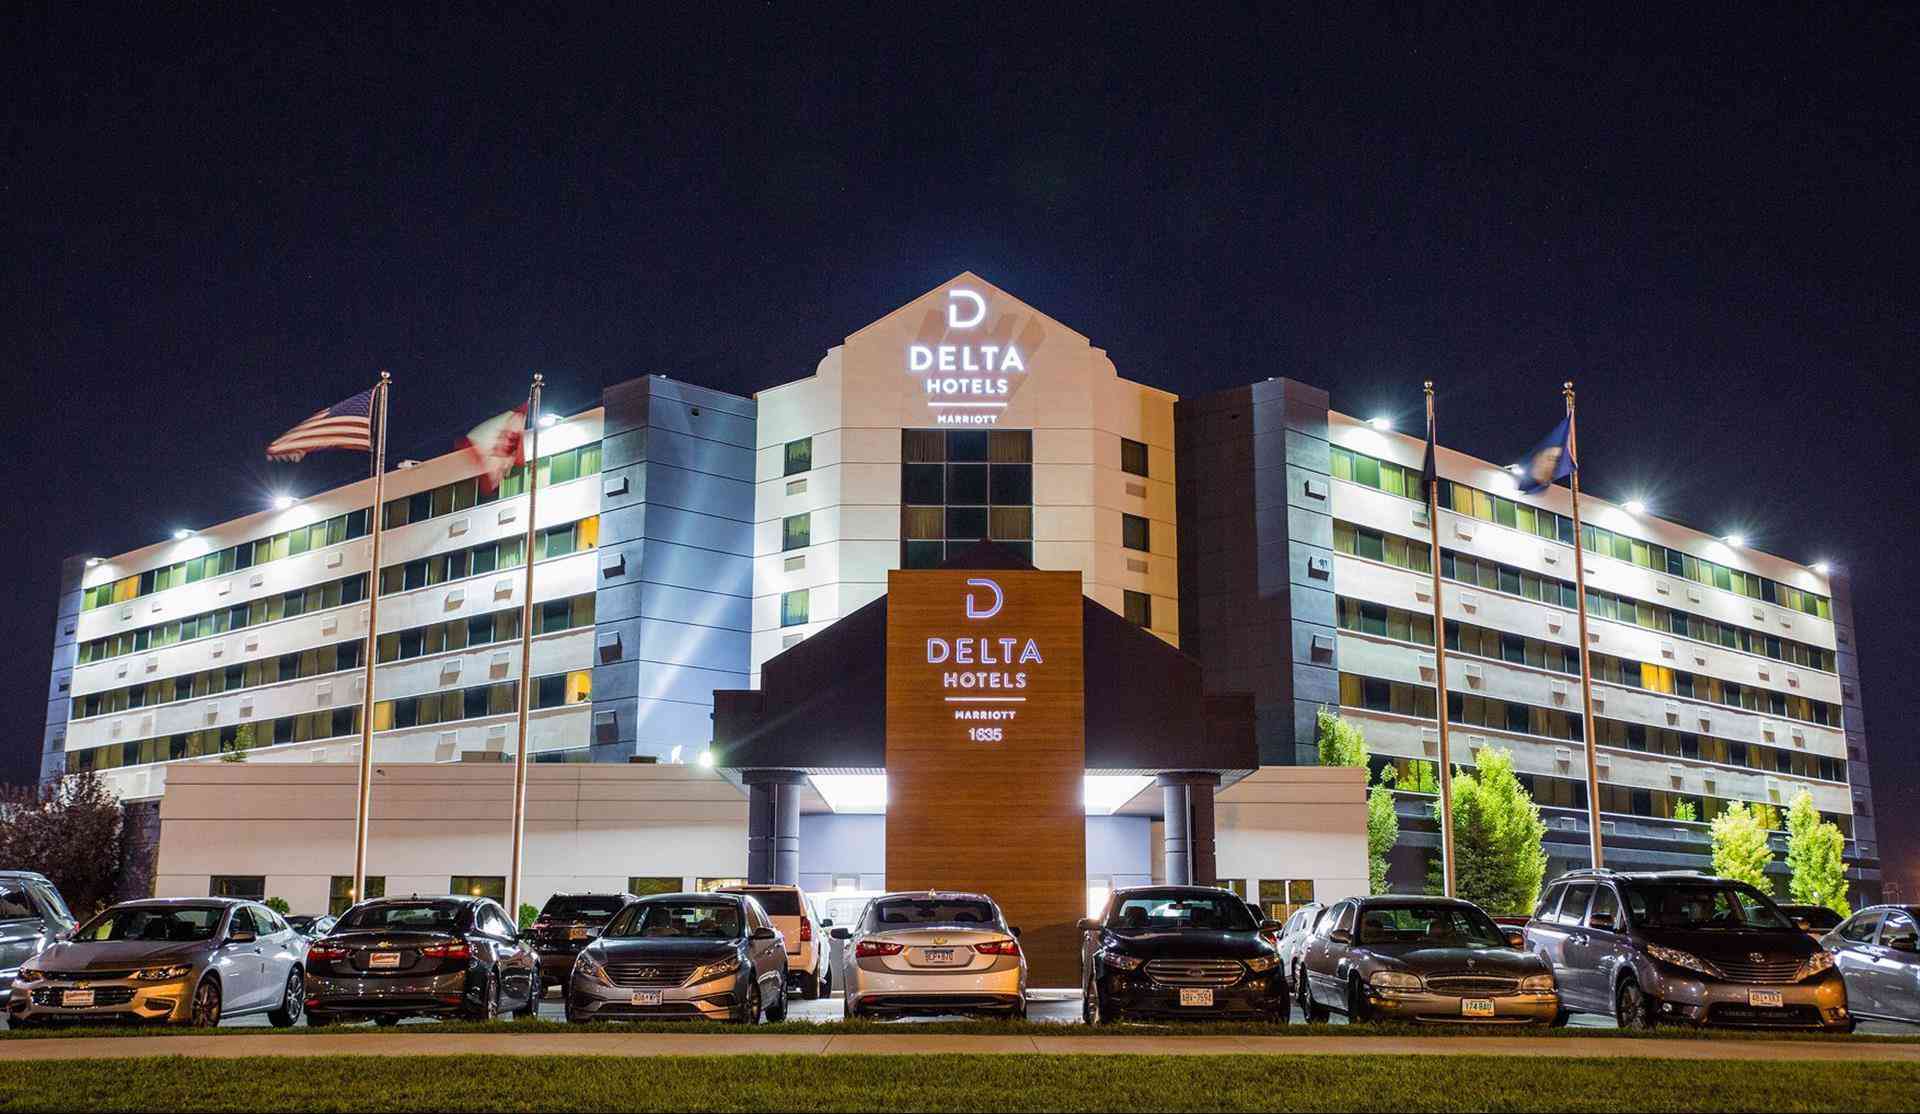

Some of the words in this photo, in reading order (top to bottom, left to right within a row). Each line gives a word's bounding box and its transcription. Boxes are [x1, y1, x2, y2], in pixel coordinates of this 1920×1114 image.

[909, 345, 1025, 372] DELTA
[926, 378, 1009, 395] HOTELS
[937, 414, 998, 425] MARRIOTT
[926, 637, 1044, 665] DELTA
[943, 671, 1028, 689] HOTELS
[954, 710, 1017, 721] MARRIOTT
